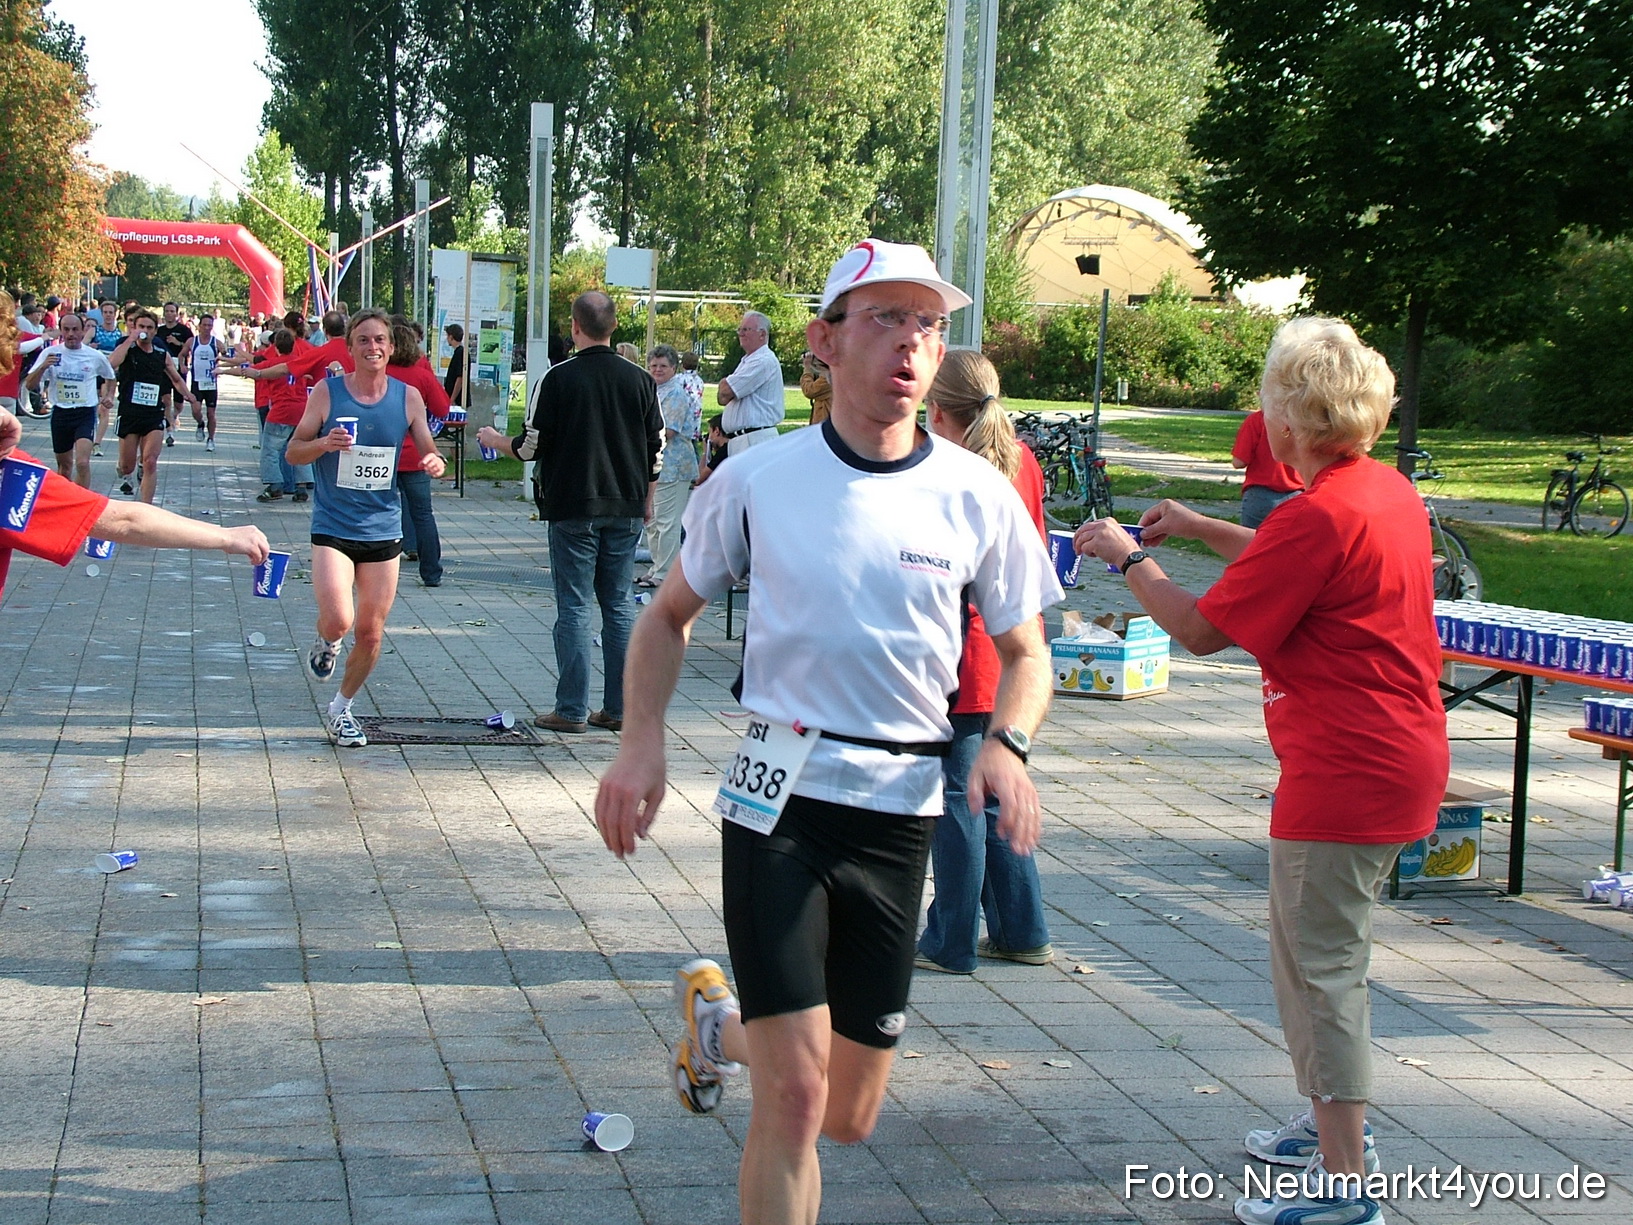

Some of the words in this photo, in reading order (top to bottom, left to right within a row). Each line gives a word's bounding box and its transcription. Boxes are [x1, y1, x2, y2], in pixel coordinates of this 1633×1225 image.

[105, 229, 168, 245] Verpflegung
[171, 234, 221, 245] LGS-Park
[140, 391, 157, 400] 3217
[354, 465, 389, 478] 3562
[899, 550, 952, 571] ERDINGER
[1055, 645, 1085, 653] PREMIUM
[1088, 647, 1120, 655] BANANAS
[747, 720, 770, 743] rst
[1438, 812, 1469, 824] ANAS
